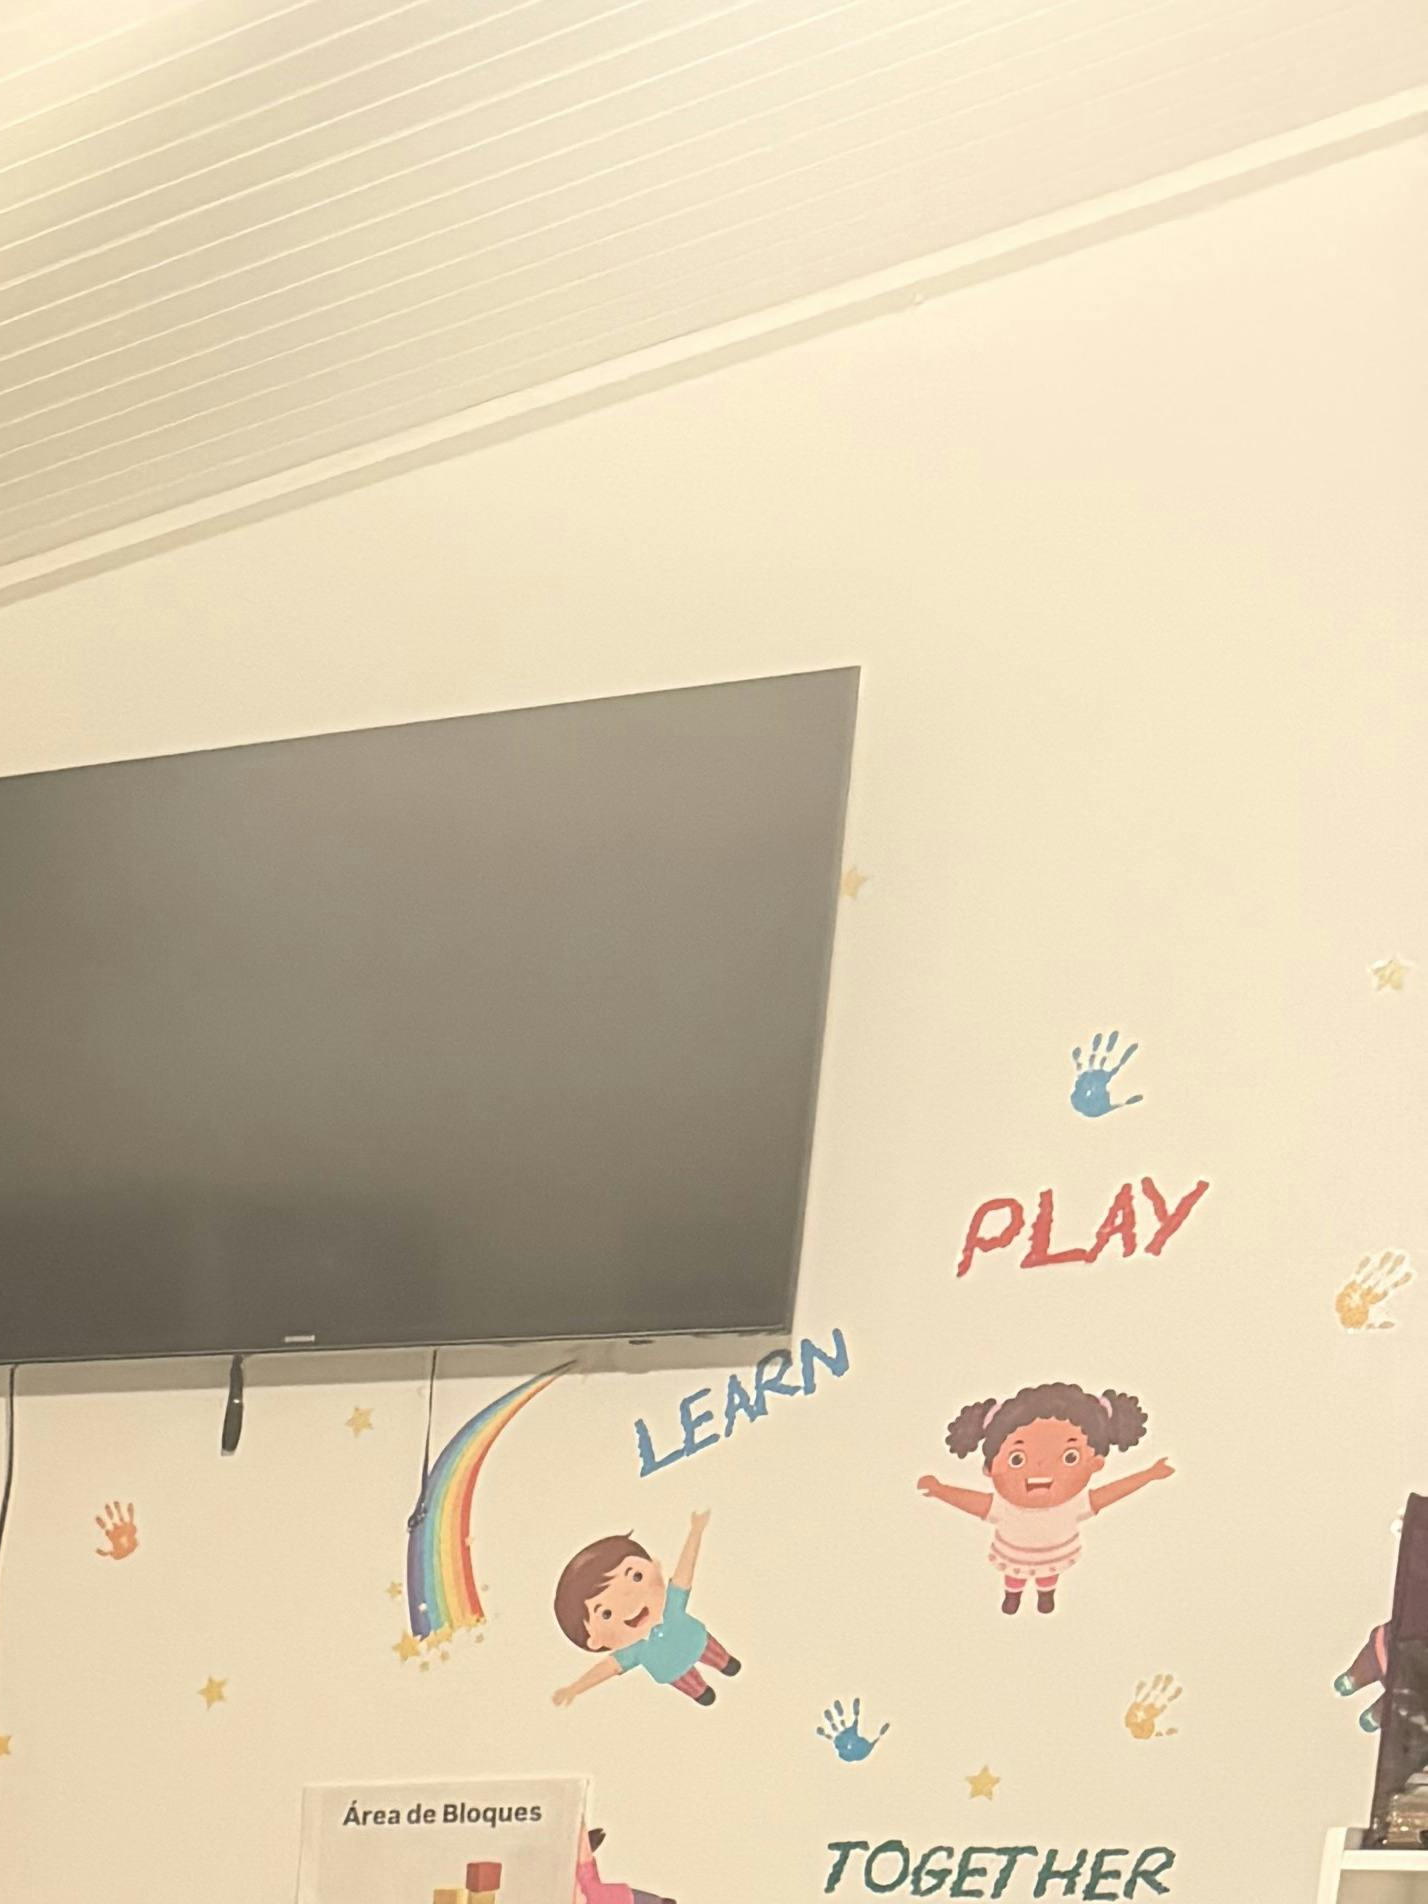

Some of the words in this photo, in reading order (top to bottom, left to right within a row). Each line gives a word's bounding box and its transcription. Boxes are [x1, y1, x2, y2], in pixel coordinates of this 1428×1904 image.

[956, 1177, 1210, 1277] PLAY
[635, 1329, 849, 1477] LEARN
[343, 1800, 401, 1826] Área
[406, 1803, 437, 1825] de
[442, 1802, 543, 1828] Bloques
[824, 1839, 1176, 1901] TOGETHER
